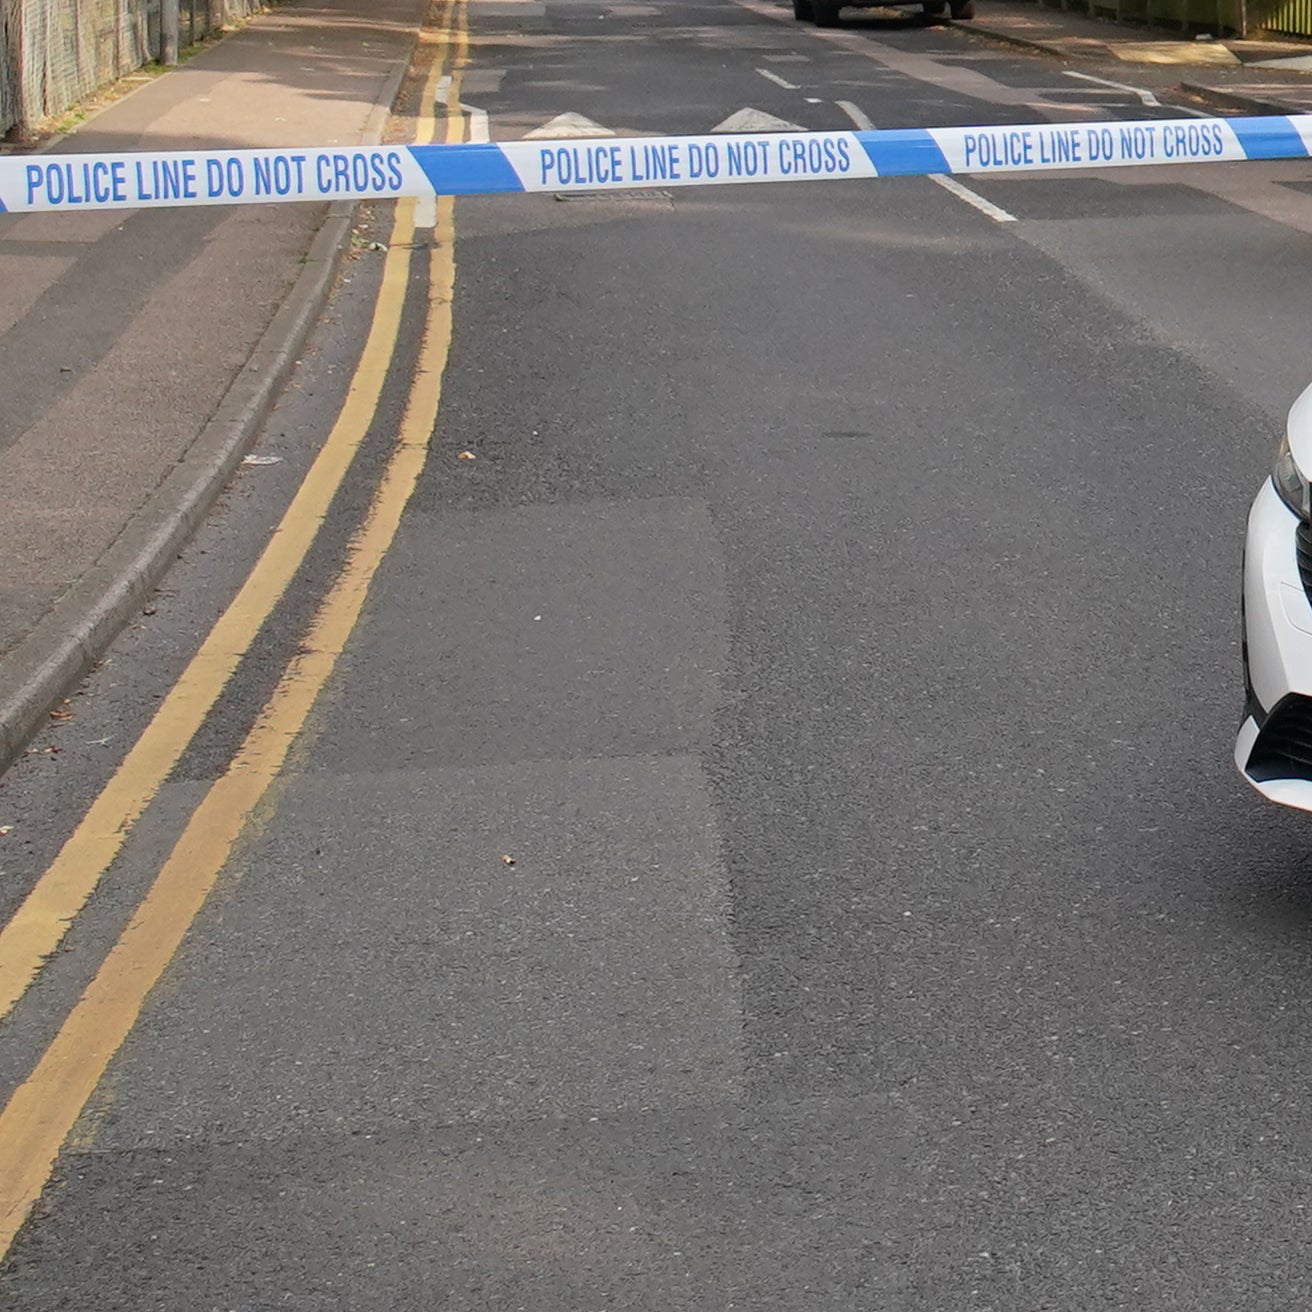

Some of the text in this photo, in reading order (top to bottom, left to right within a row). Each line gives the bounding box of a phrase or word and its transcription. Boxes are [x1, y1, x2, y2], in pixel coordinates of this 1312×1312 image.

[540, 138, 850, 185] POLICE LINE DO NOT CROSS
[964, 123, 1224, 167] POLICE LINE DO NOT CROSS
[26, 152, 403, 205] POLICE LINE DO NOT CROSS
